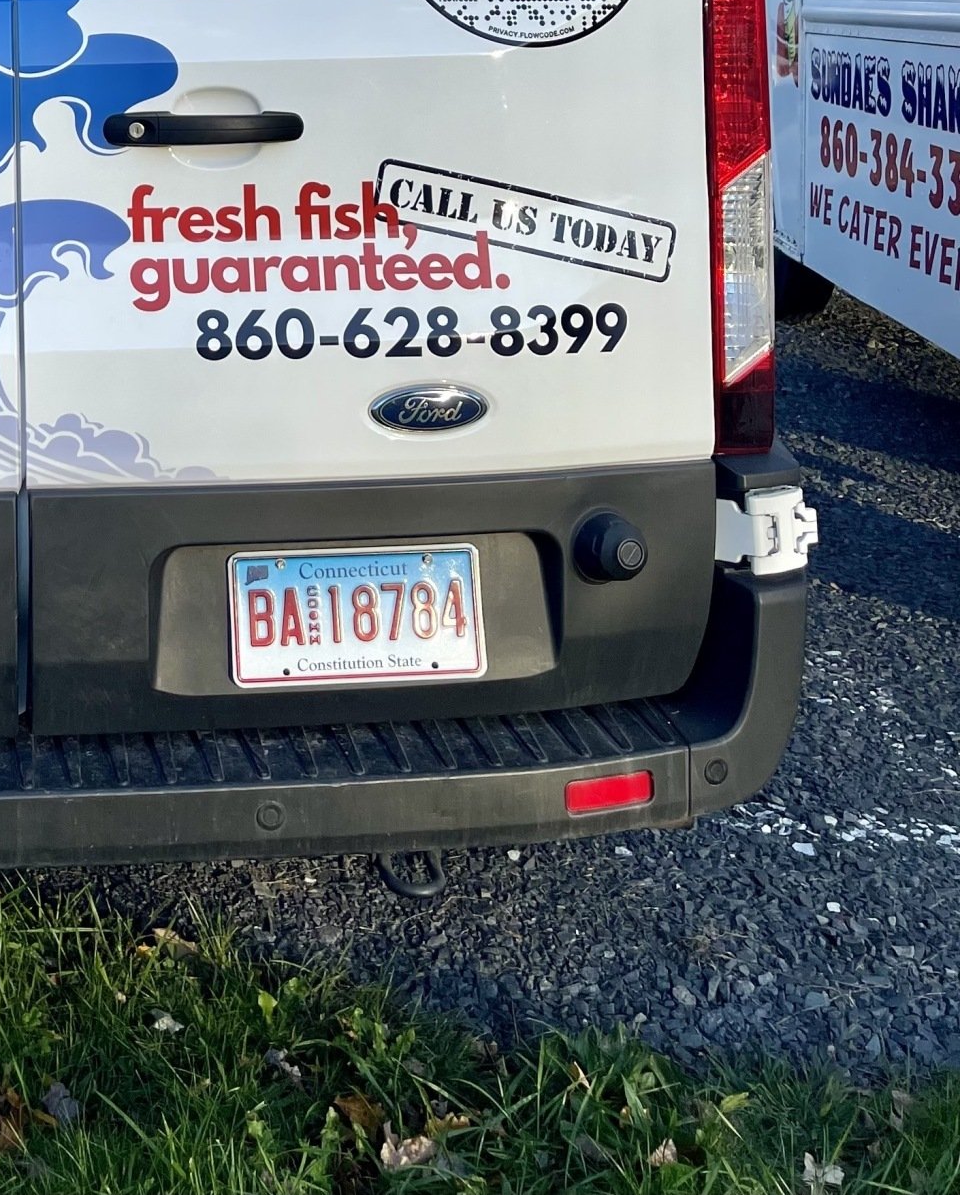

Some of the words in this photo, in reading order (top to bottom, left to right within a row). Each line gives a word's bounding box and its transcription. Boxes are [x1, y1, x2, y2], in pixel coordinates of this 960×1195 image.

[488, 25, 576, 40] PRIVACY.FLOWCODE.COM
[810, 47, 892, 117] SUNDAES
[127, 183, 282, 243] fresh
[294, 180, 418, 250] fish,
[388, 177, 479, 224] CALL
[491, 198, 539, 237] US
[550, 212, 664, 265] TODAY
[810, 182, 834, 226] WE
[838, 195, 903, 259] CATER
[909, 224, 960, 292] EVE
[129, 230, 511, 313] guaranteed.
[195, 302, 629, 361] 860-628-8399
[398, 394, 464, 424] Ford
[298, 561, 408, 580] Connecticut
[247, 586, 306, 647] BA
[327, 576, 468, 644] 18784
[296, 656, 384, 673] Constitution
[386, 654, 423, 669] State
